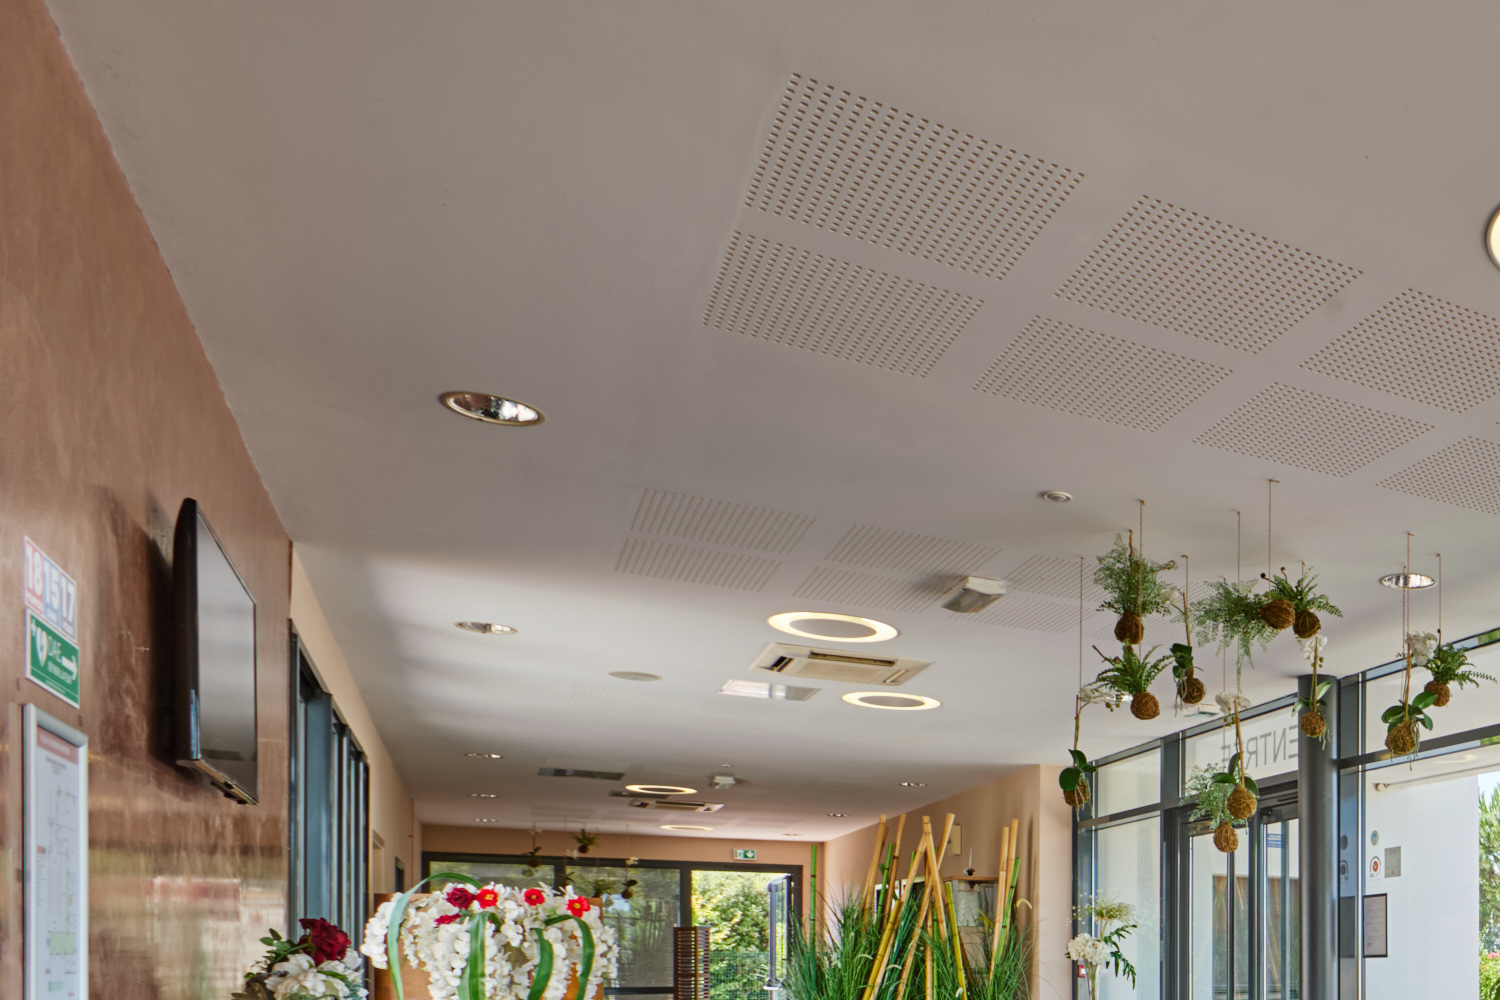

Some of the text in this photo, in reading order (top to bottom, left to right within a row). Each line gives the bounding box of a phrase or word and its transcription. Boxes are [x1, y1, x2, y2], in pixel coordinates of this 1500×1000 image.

[26, 545, 43, 597] 18
[44, 560, 60, 611] 15
[61, 574, 76, 623] 17
[48, 635, 62, 663] DAE
